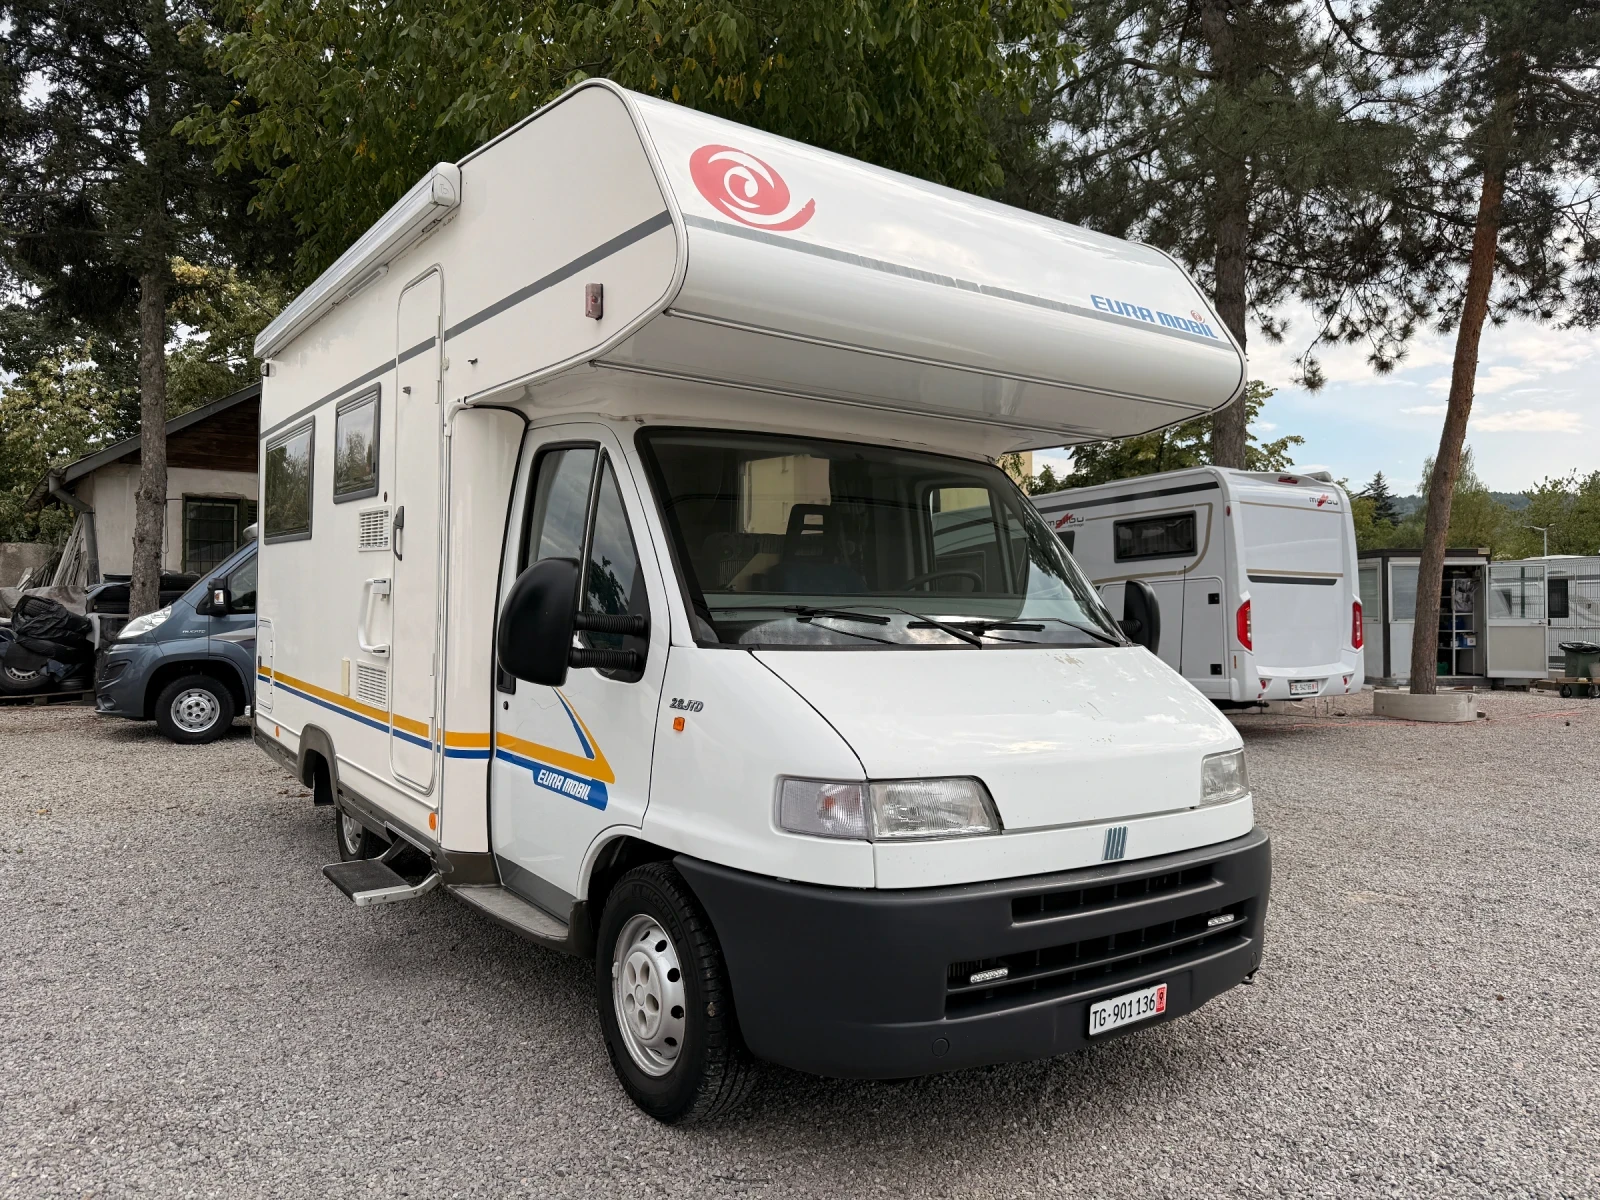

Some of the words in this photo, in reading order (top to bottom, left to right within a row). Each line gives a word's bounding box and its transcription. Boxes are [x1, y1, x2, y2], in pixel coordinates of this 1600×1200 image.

[1090, 294, 1155, 323] EURA
[1156, 311, 1219, 339] MOBIL
[537, 769, 565, 790] EURA
[562, 777, 591, 801] MOBIL
